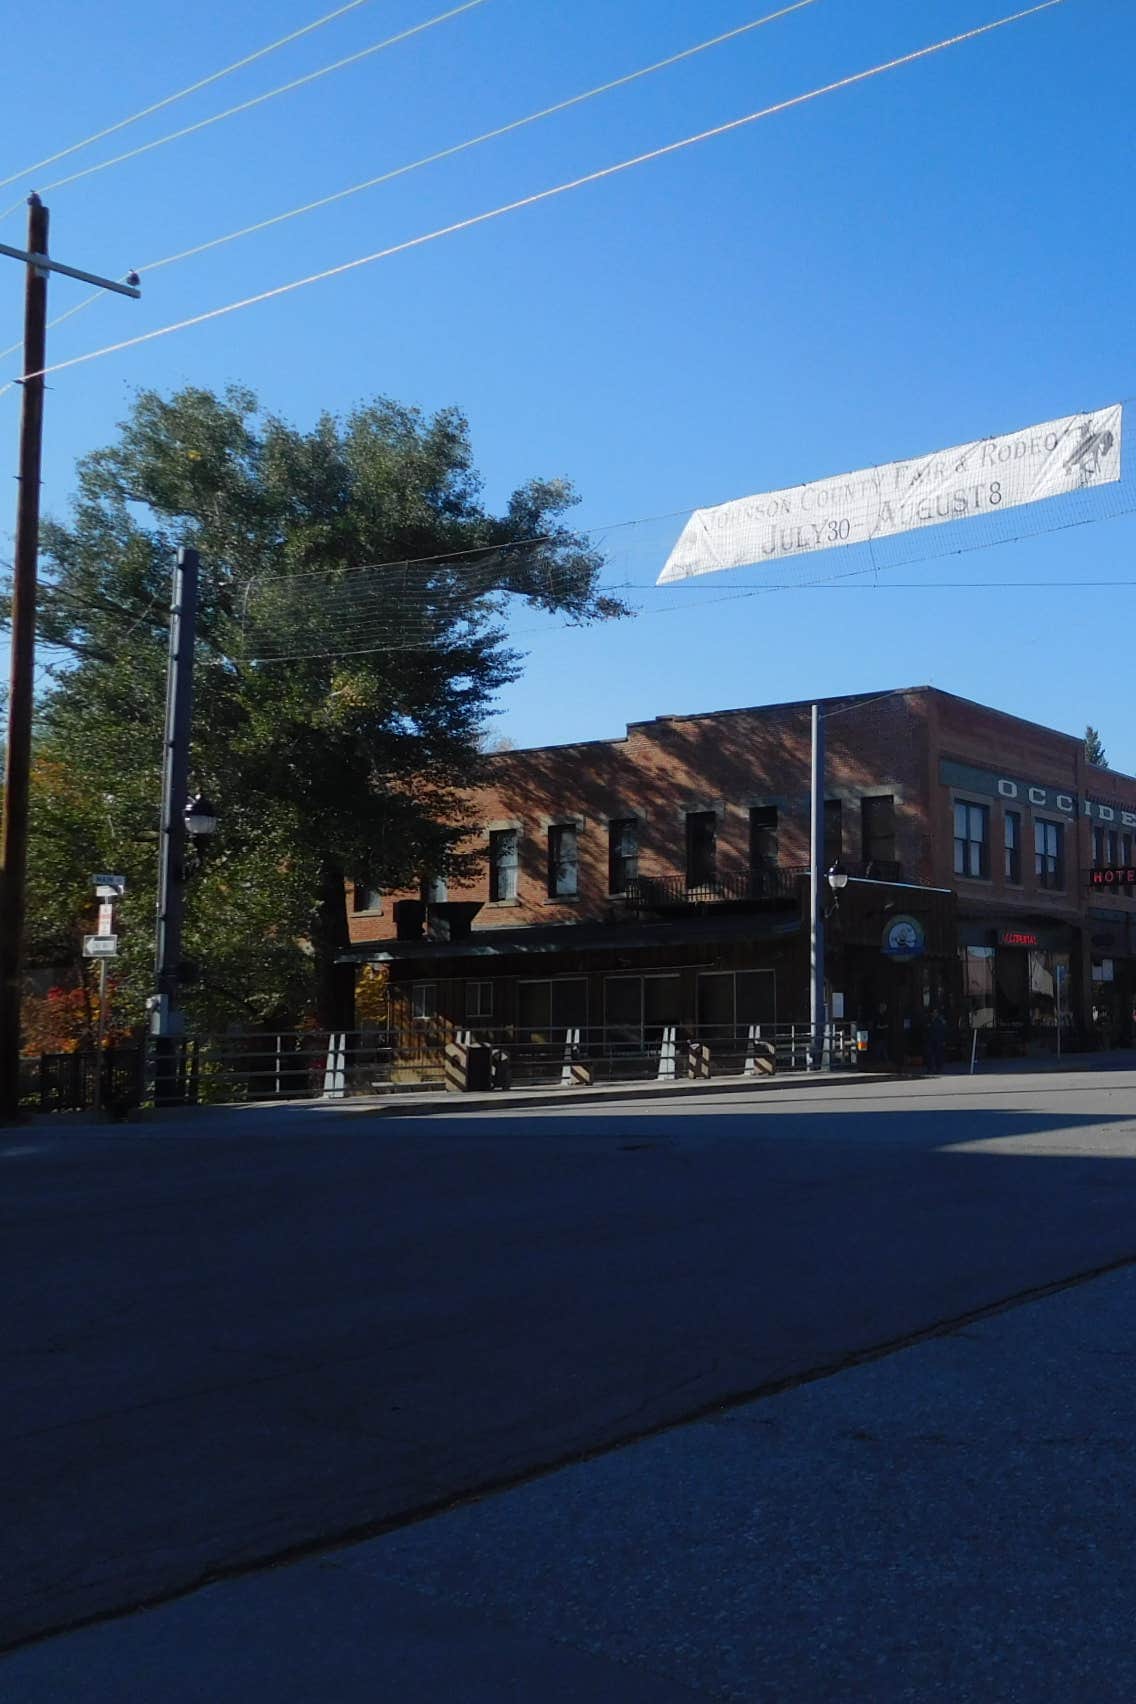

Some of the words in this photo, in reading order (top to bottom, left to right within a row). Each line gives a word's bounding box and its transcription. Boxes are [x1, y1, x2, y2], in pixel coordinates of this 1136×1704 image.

[800, 472, 885, 512] COUNTY
[953, 454, 970, 474] &
[980, 431, 1060, 469] RODEO
